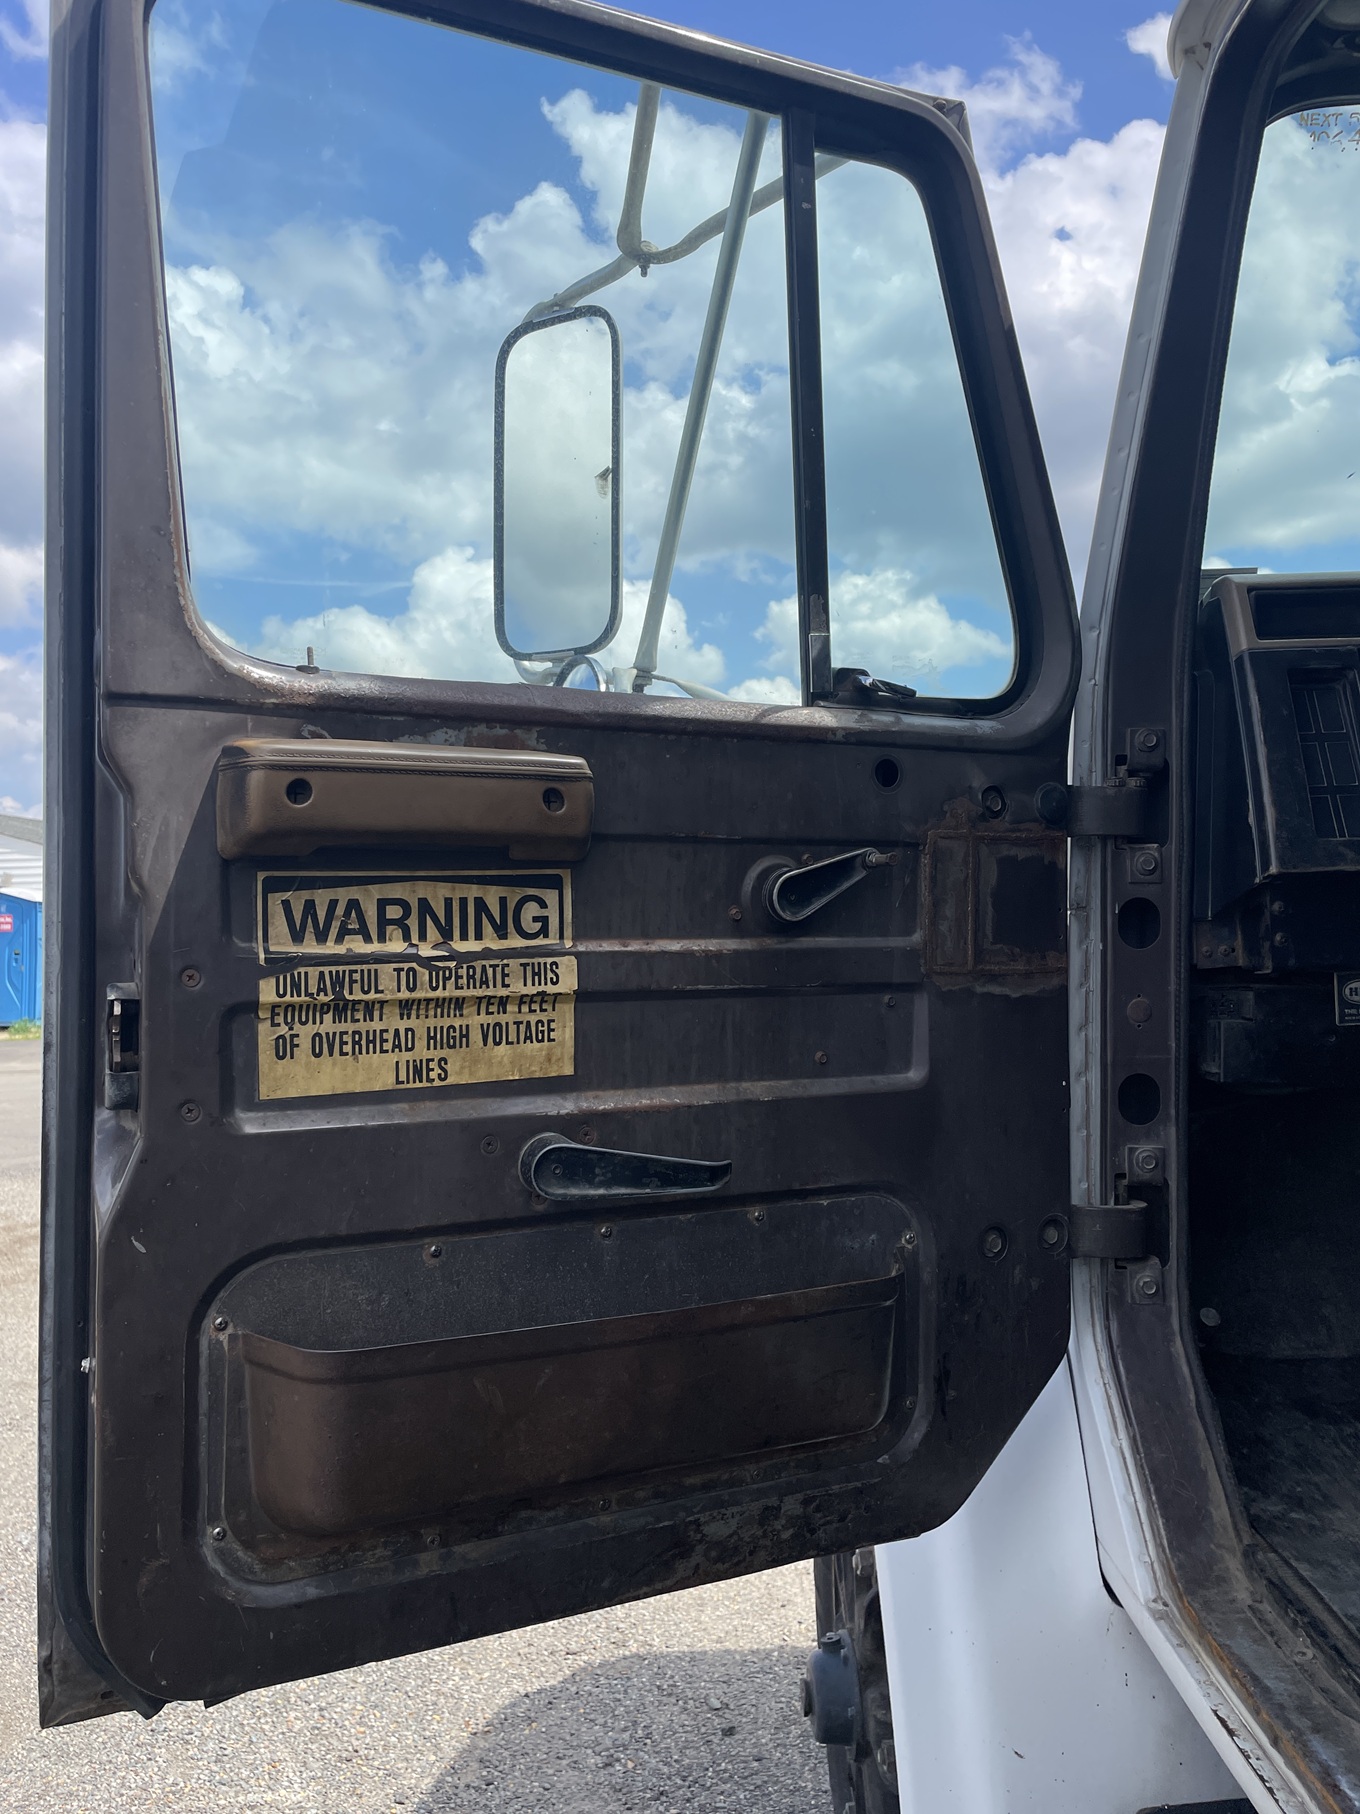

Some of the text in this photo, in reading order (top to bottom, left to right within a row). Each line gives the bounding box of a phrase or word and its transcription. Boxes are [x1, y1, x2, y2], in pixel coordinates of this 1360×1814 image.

[1300, 111, 1343, 128] NEXT
[281, 894, 550, 946] WARNING
[275, 961, 560, 999] UNLAWFUL TO OPERATE THIS
[270, 992, 562, 1031] EQUIPMENT WITHIN TEN FEET
[275, 1019, 556, 1061] OF OVERHEAD HIGH VOLTAGE
[395, 1057, 449, 1085] LINES
